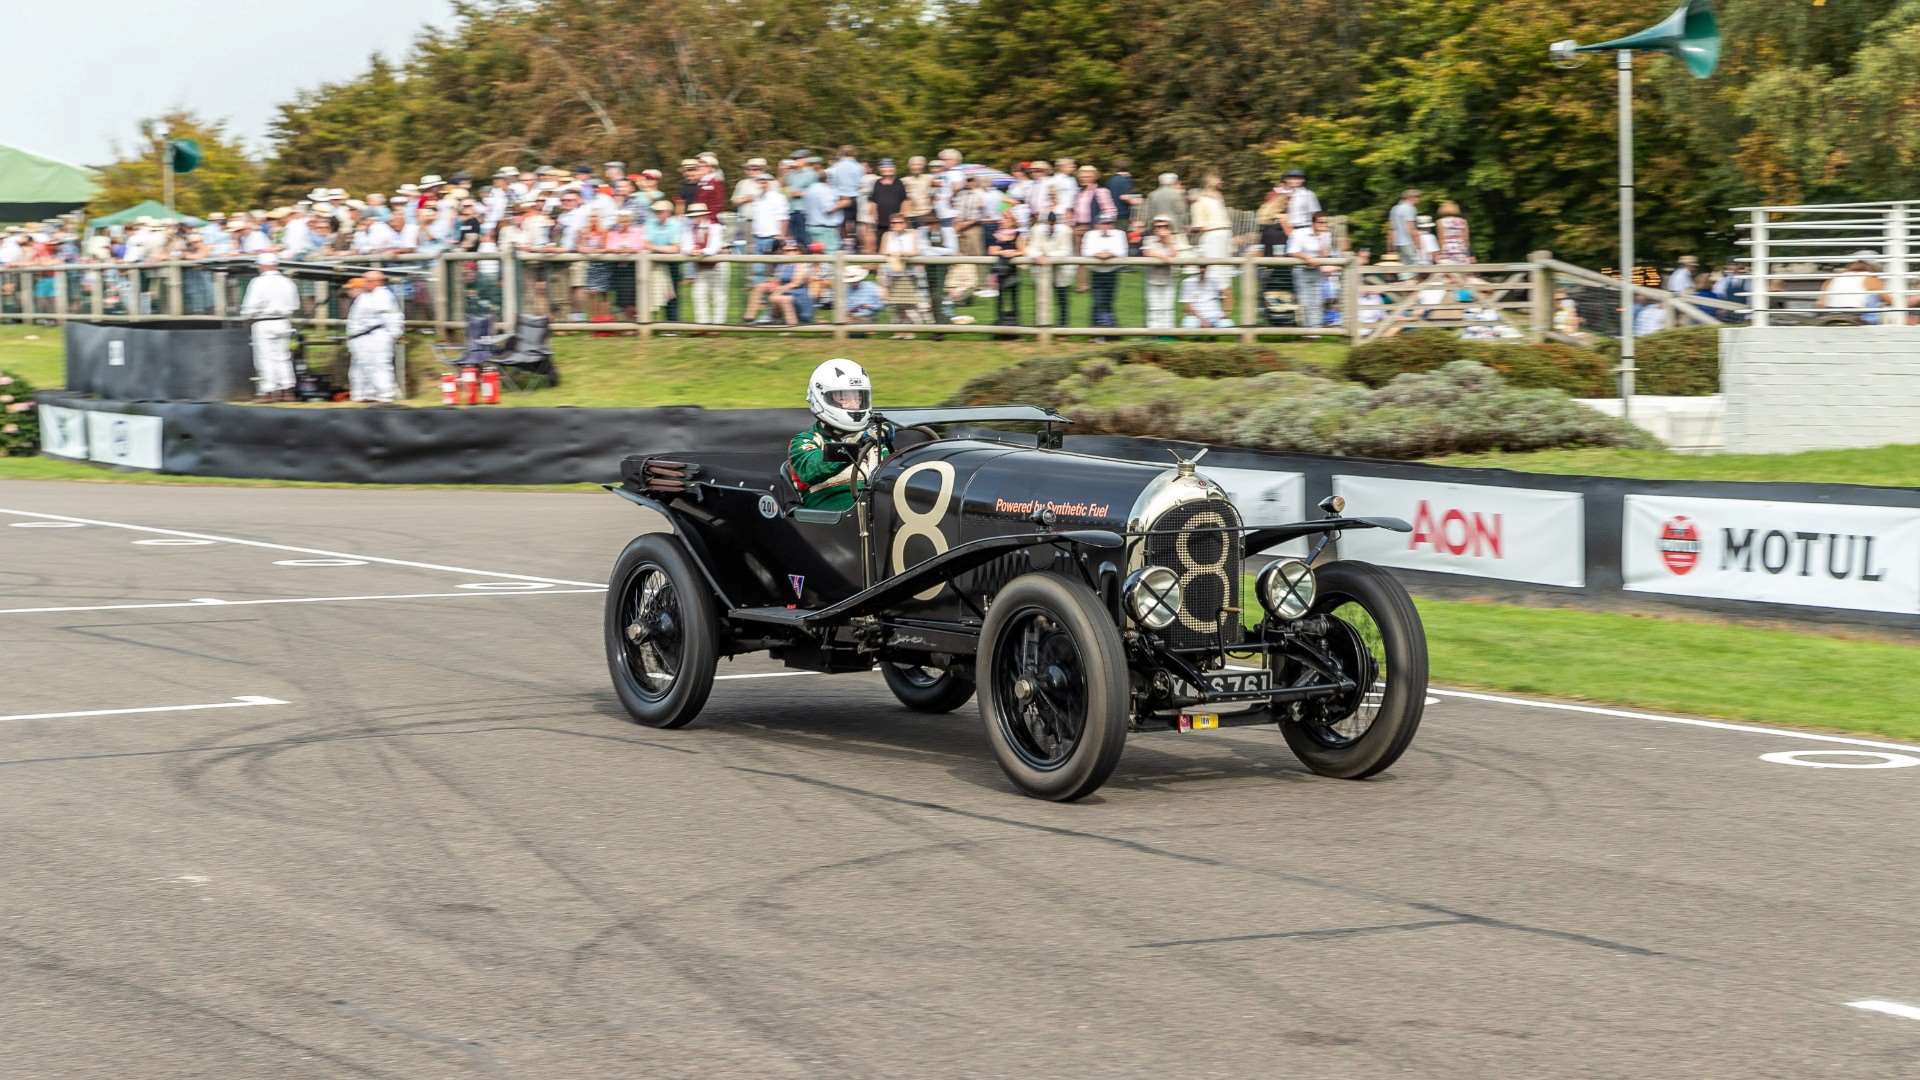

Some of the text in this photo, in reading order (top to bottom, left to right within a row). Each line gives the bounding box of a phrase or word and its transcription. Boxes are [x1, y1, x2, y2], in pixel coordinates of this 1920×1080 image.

[892, 460, 955, 600] 8
[995, 498, 1034, 513] Powered
[1047, 501, 1088, 517] Synthetic
[1088, 503, 1109, 518] Fuel
[1408, 499, 1504, 559] AON
[1176, 511, 1230, 633] 8
[1720, 527, 1887, 582] MOTUL
